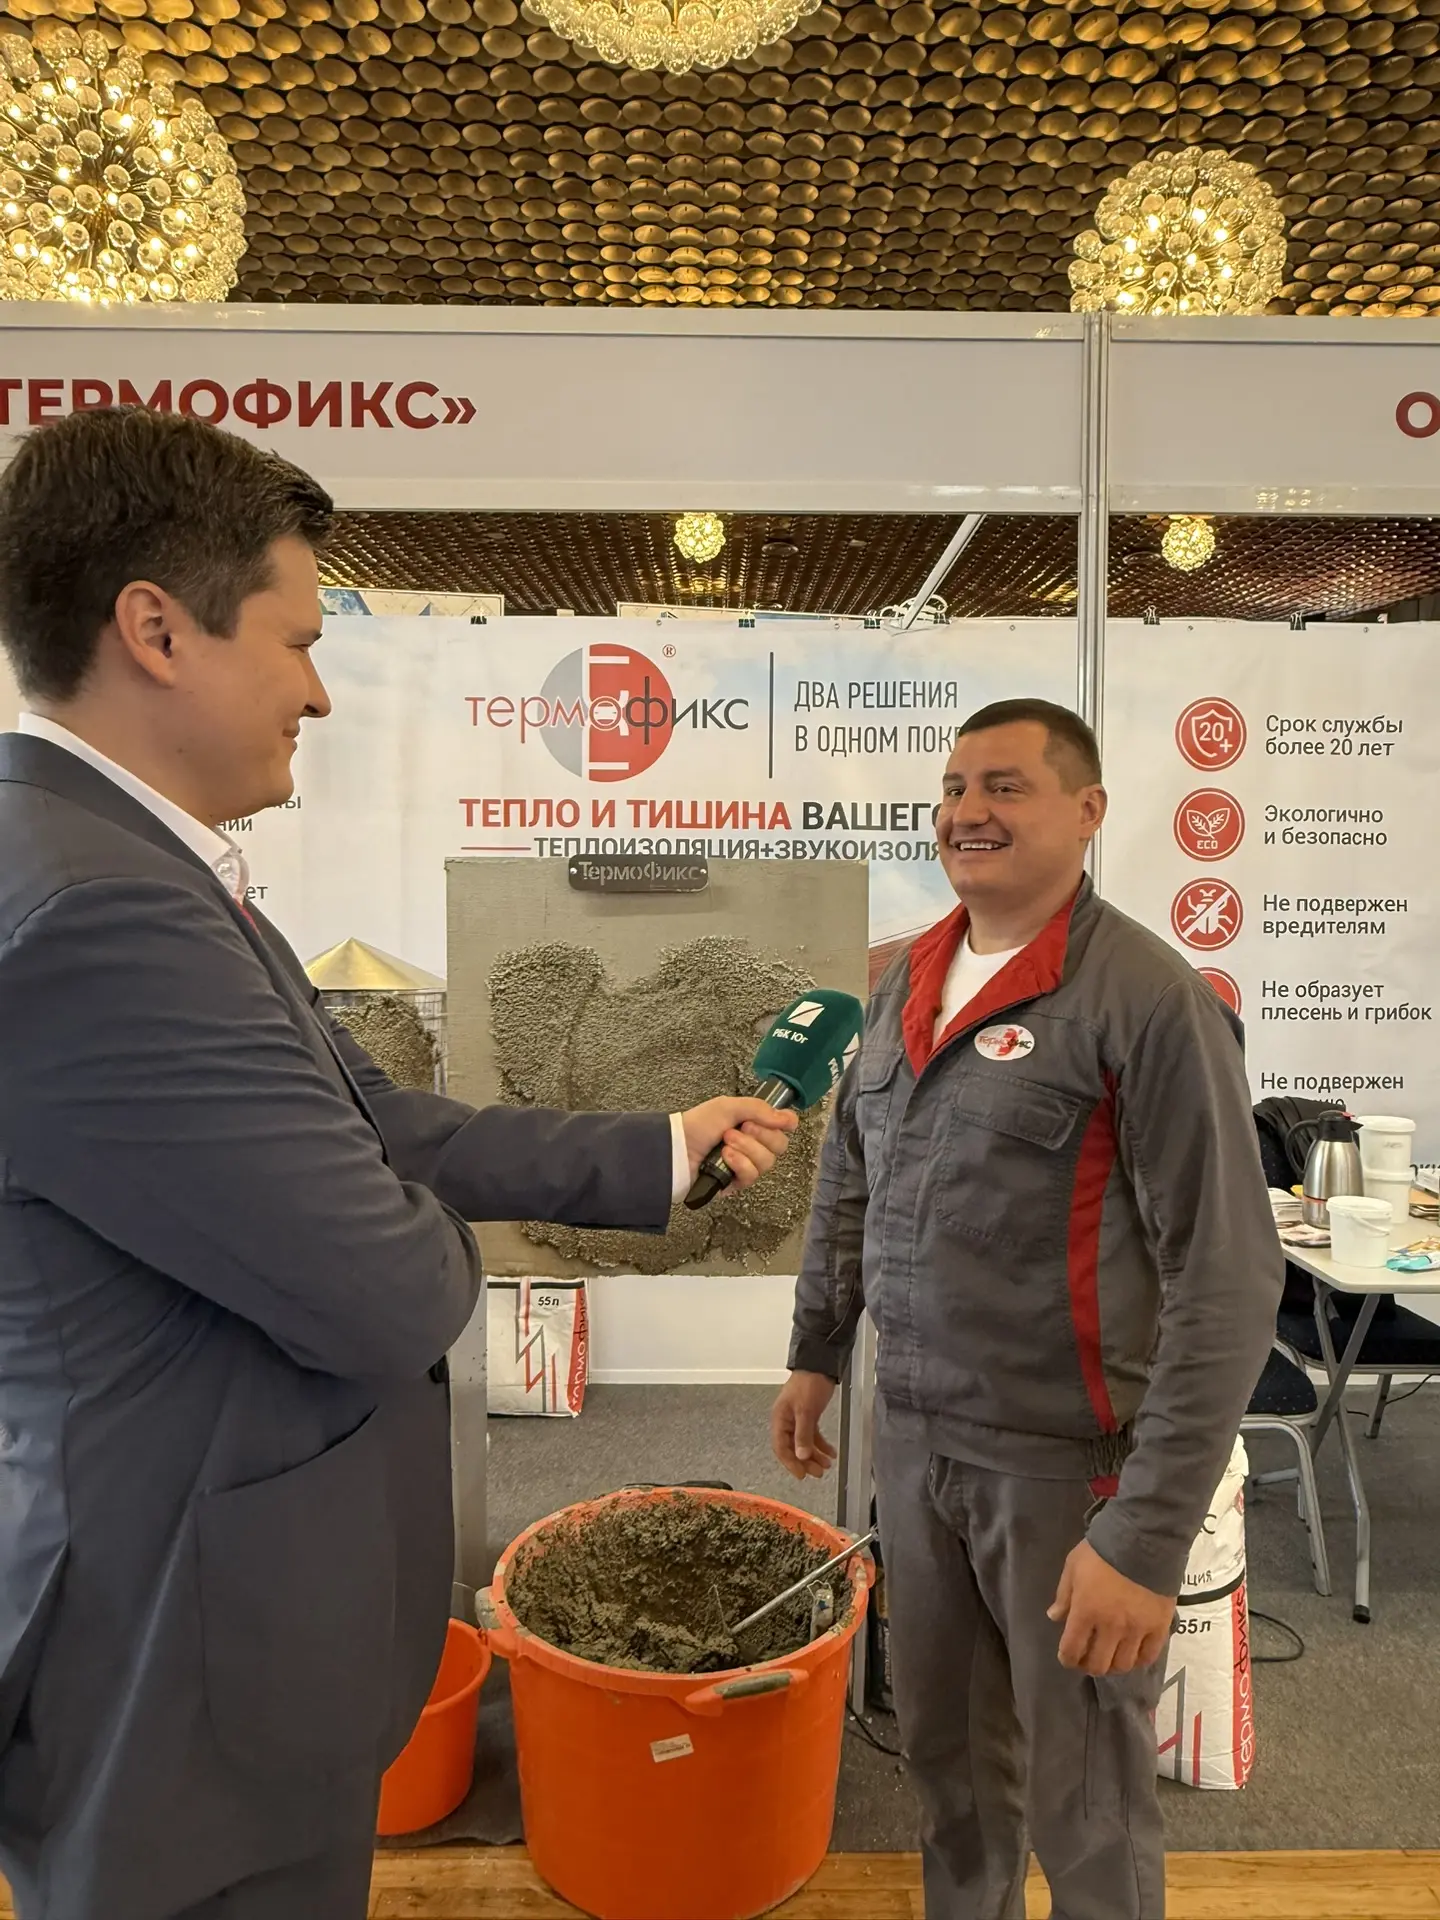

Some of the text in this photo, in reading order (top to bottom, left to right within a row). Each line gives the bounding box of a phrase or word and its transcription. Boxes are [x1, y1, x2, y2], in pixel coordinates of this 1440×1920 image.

[794, 681, 958, 712] ДВА РЕШЕНИЯ
[465, 675, 749, 745] термофикс
[1265, 714, 1403, 738] Срок службы
[795, 725, 808, 752] В
[817, 725, 898, 757] ОДНОМ
[1265, 737, 1395, 756] более 20 лет
[459, 798, 580, 828] ТЕПЛО
[592, 799, 615, 828] И
[626, 799, 793, 830] ТИШИНА
[1264, 804, 1384, 824] Экологично
[1264, 827, 1388, 846] и безопасно
[1263, 894, 1408, 917] Не подвержен
[1263, 920, 1386, 938] вредителям
[1262, 980, 1384, 1002] Не образует
[1261, 1003, 1432, 1024] плесень и грибок
[772, 1028, 792, 1039] РБК
[1261, 1072, 1404, 1093] Не подвержен
